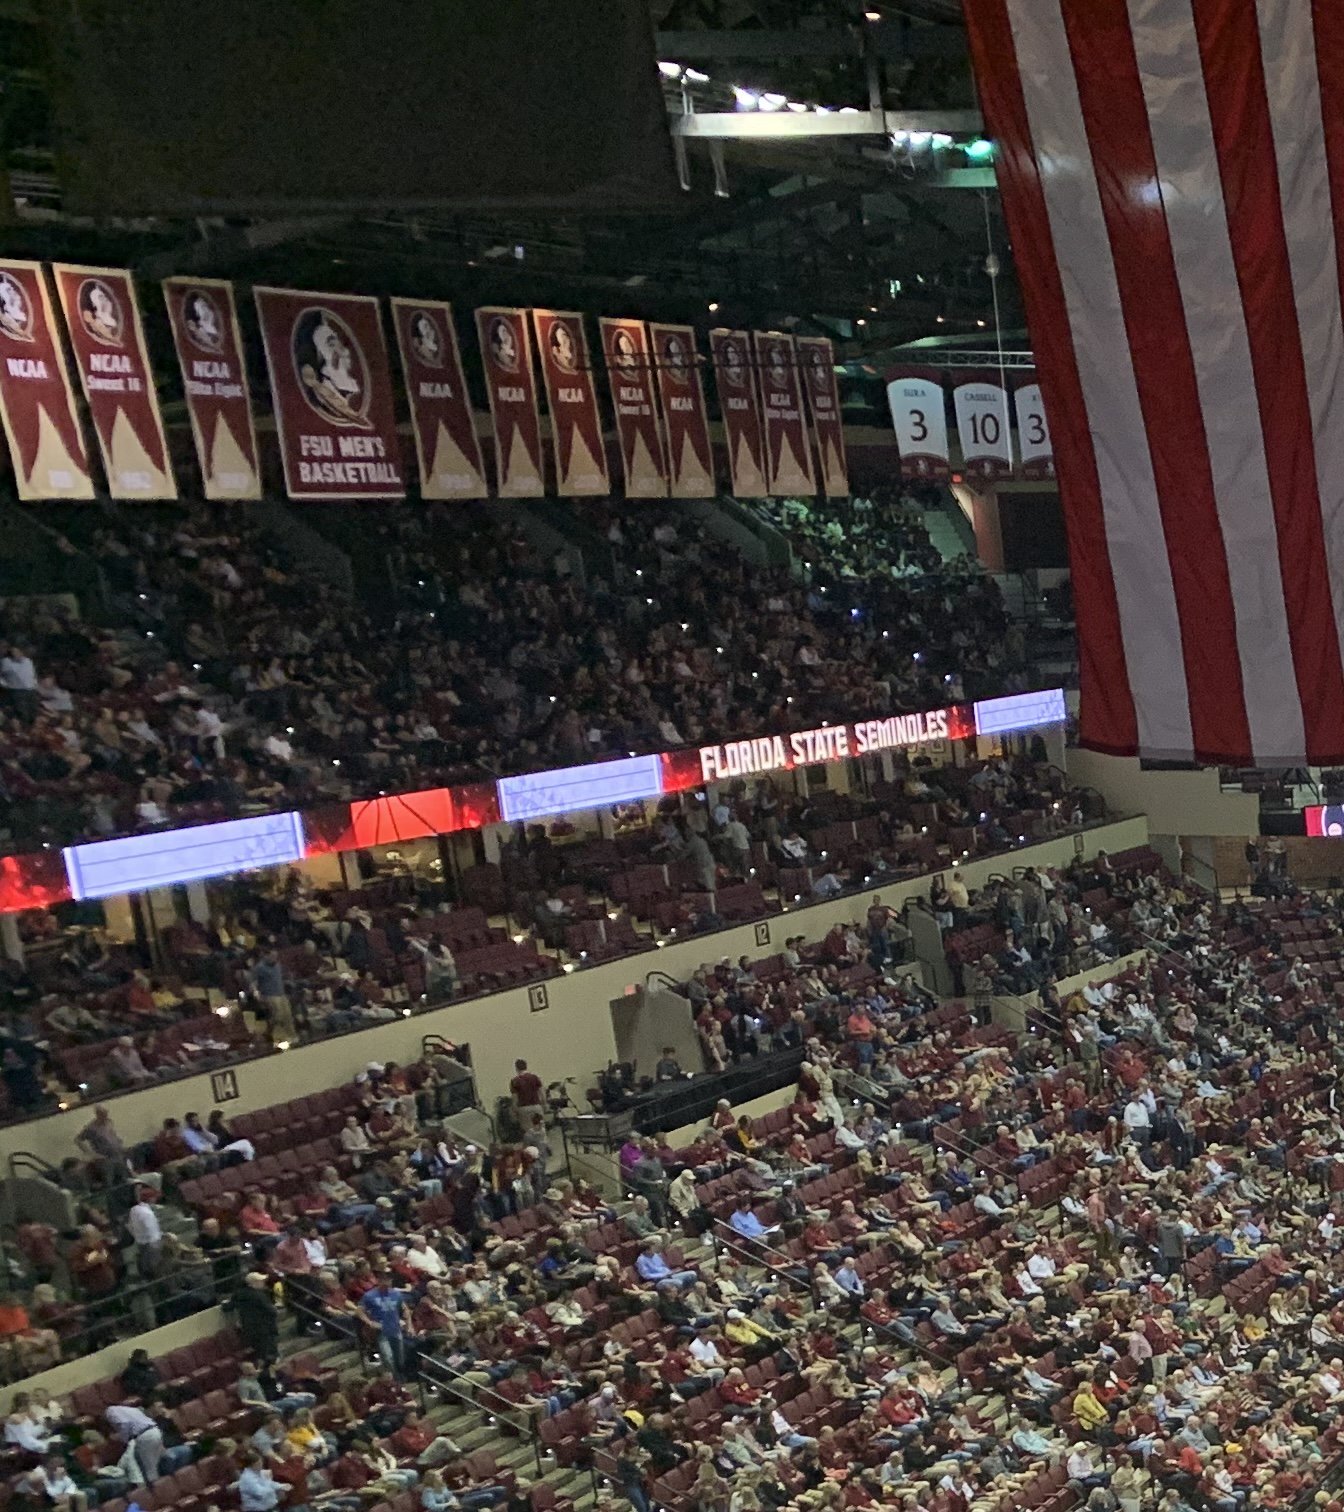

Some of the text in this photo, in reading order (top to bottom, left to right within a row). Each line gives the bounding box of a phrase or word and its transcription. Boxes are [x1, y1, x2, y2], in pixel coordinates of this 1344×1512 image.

[6, 358, 48, 379] NCAA
[90, 353, 133, 373] NCAA
[193, 360, 231, 379] NCAA
[909, 408, 928, 442] 3
[969, 412, 1000, 445] 10
[300, 435, 386, 458] FSU MEN'S
[298, 462, 400, 484] BASKETBALL
[699, 708, 948, 781] FLORIDA STATE SEMINOLES
